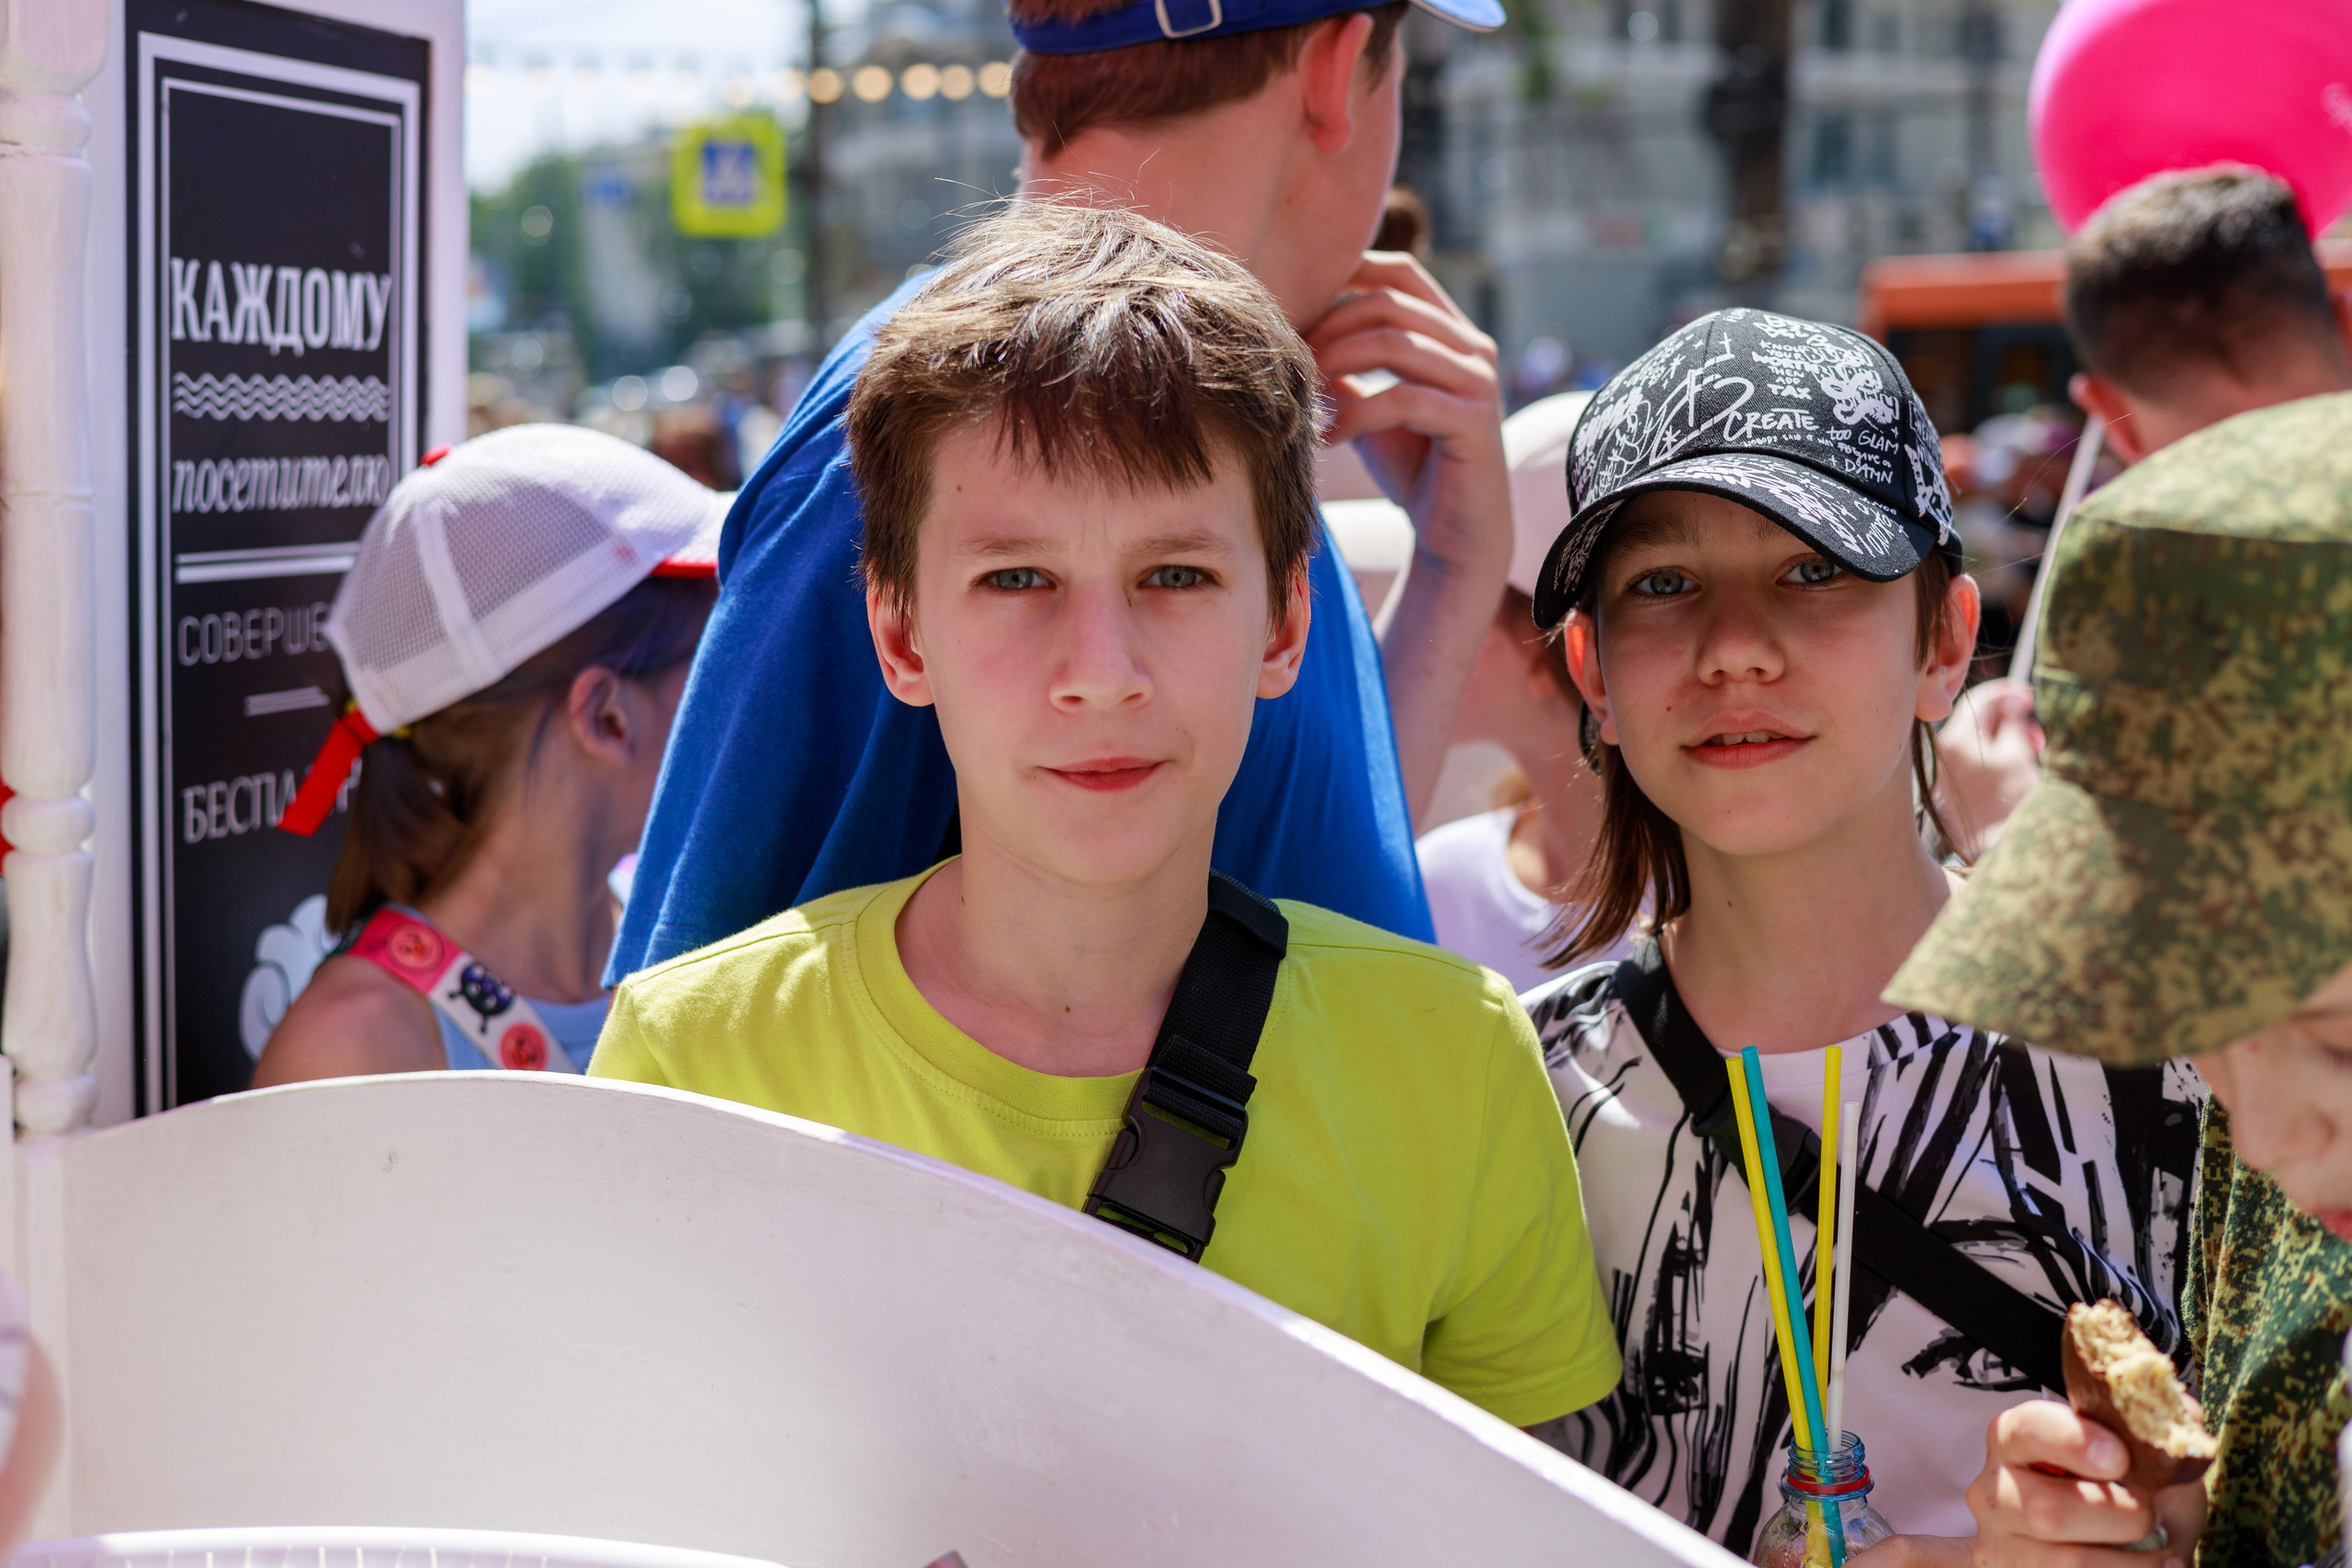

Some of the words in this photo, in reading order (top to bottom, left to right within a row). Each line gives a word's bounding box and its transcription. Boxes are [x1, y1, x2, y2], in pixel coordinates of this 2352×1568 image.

[170, 256, 392, 356] КАЖДОМУ
[1766, 383, 1813, 400] TAX
[1775, 376, 1801, 385] ADD
[1723, 408, 1820, 442] CREATE
[1858, 430, 1899, 456] GLAM
[172, 454, 390, 513] посетителю
[1845, 458, 1893, 484] DAMN
[177, 601, 331, 667] СОВЕРШЕ
[181, 758, 362, 844] БЕСПЛ
